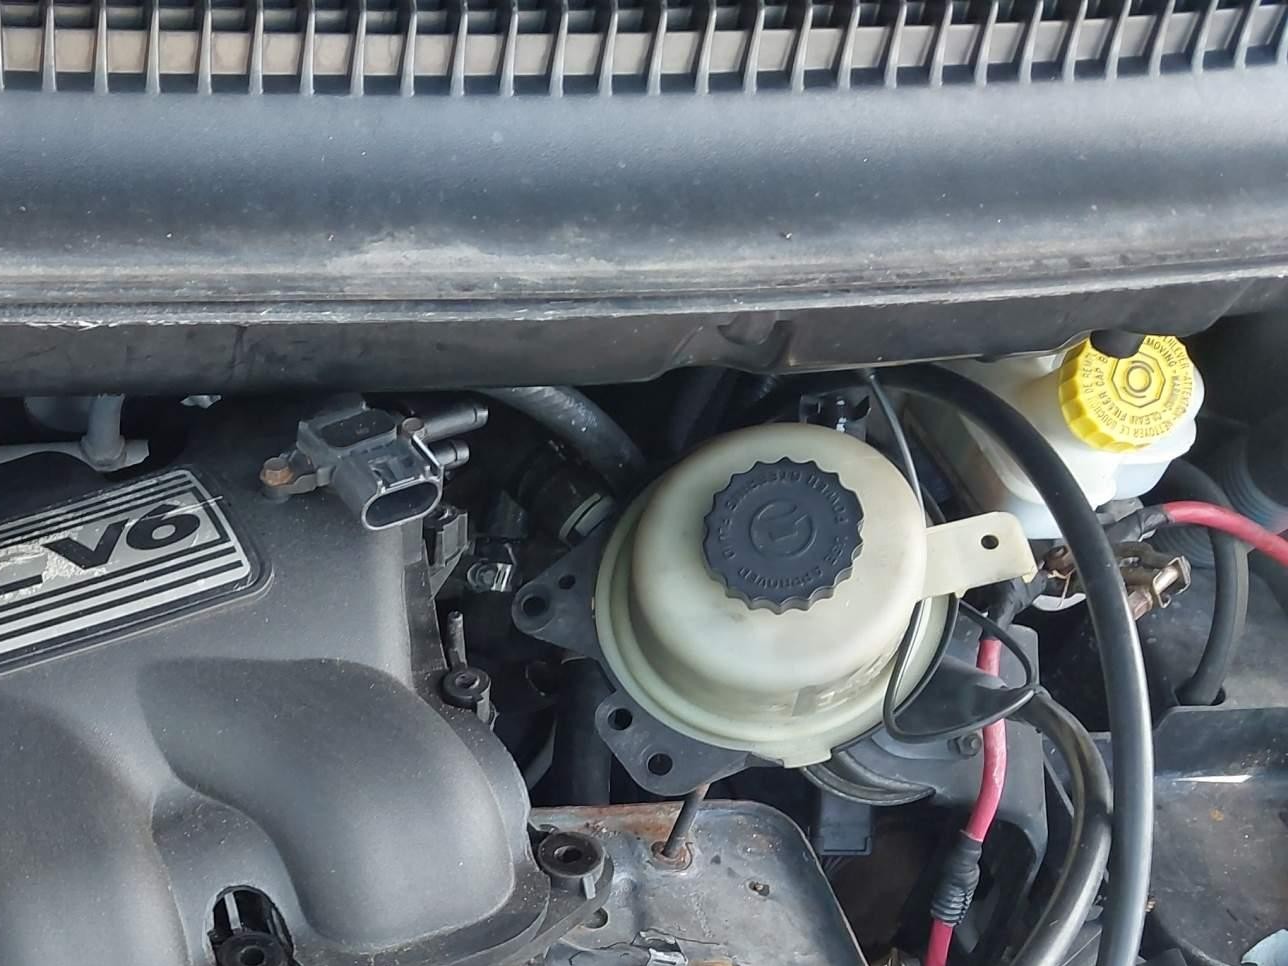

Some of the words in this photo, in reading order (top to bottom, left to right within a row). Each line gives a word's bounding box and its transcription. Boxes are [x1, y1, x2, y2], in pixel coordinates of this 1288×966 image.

[1095, 367, 1105, 387] CAP
[1145, 336, 1177, 367] MOVING
[44, 503, 200, 570] V6
